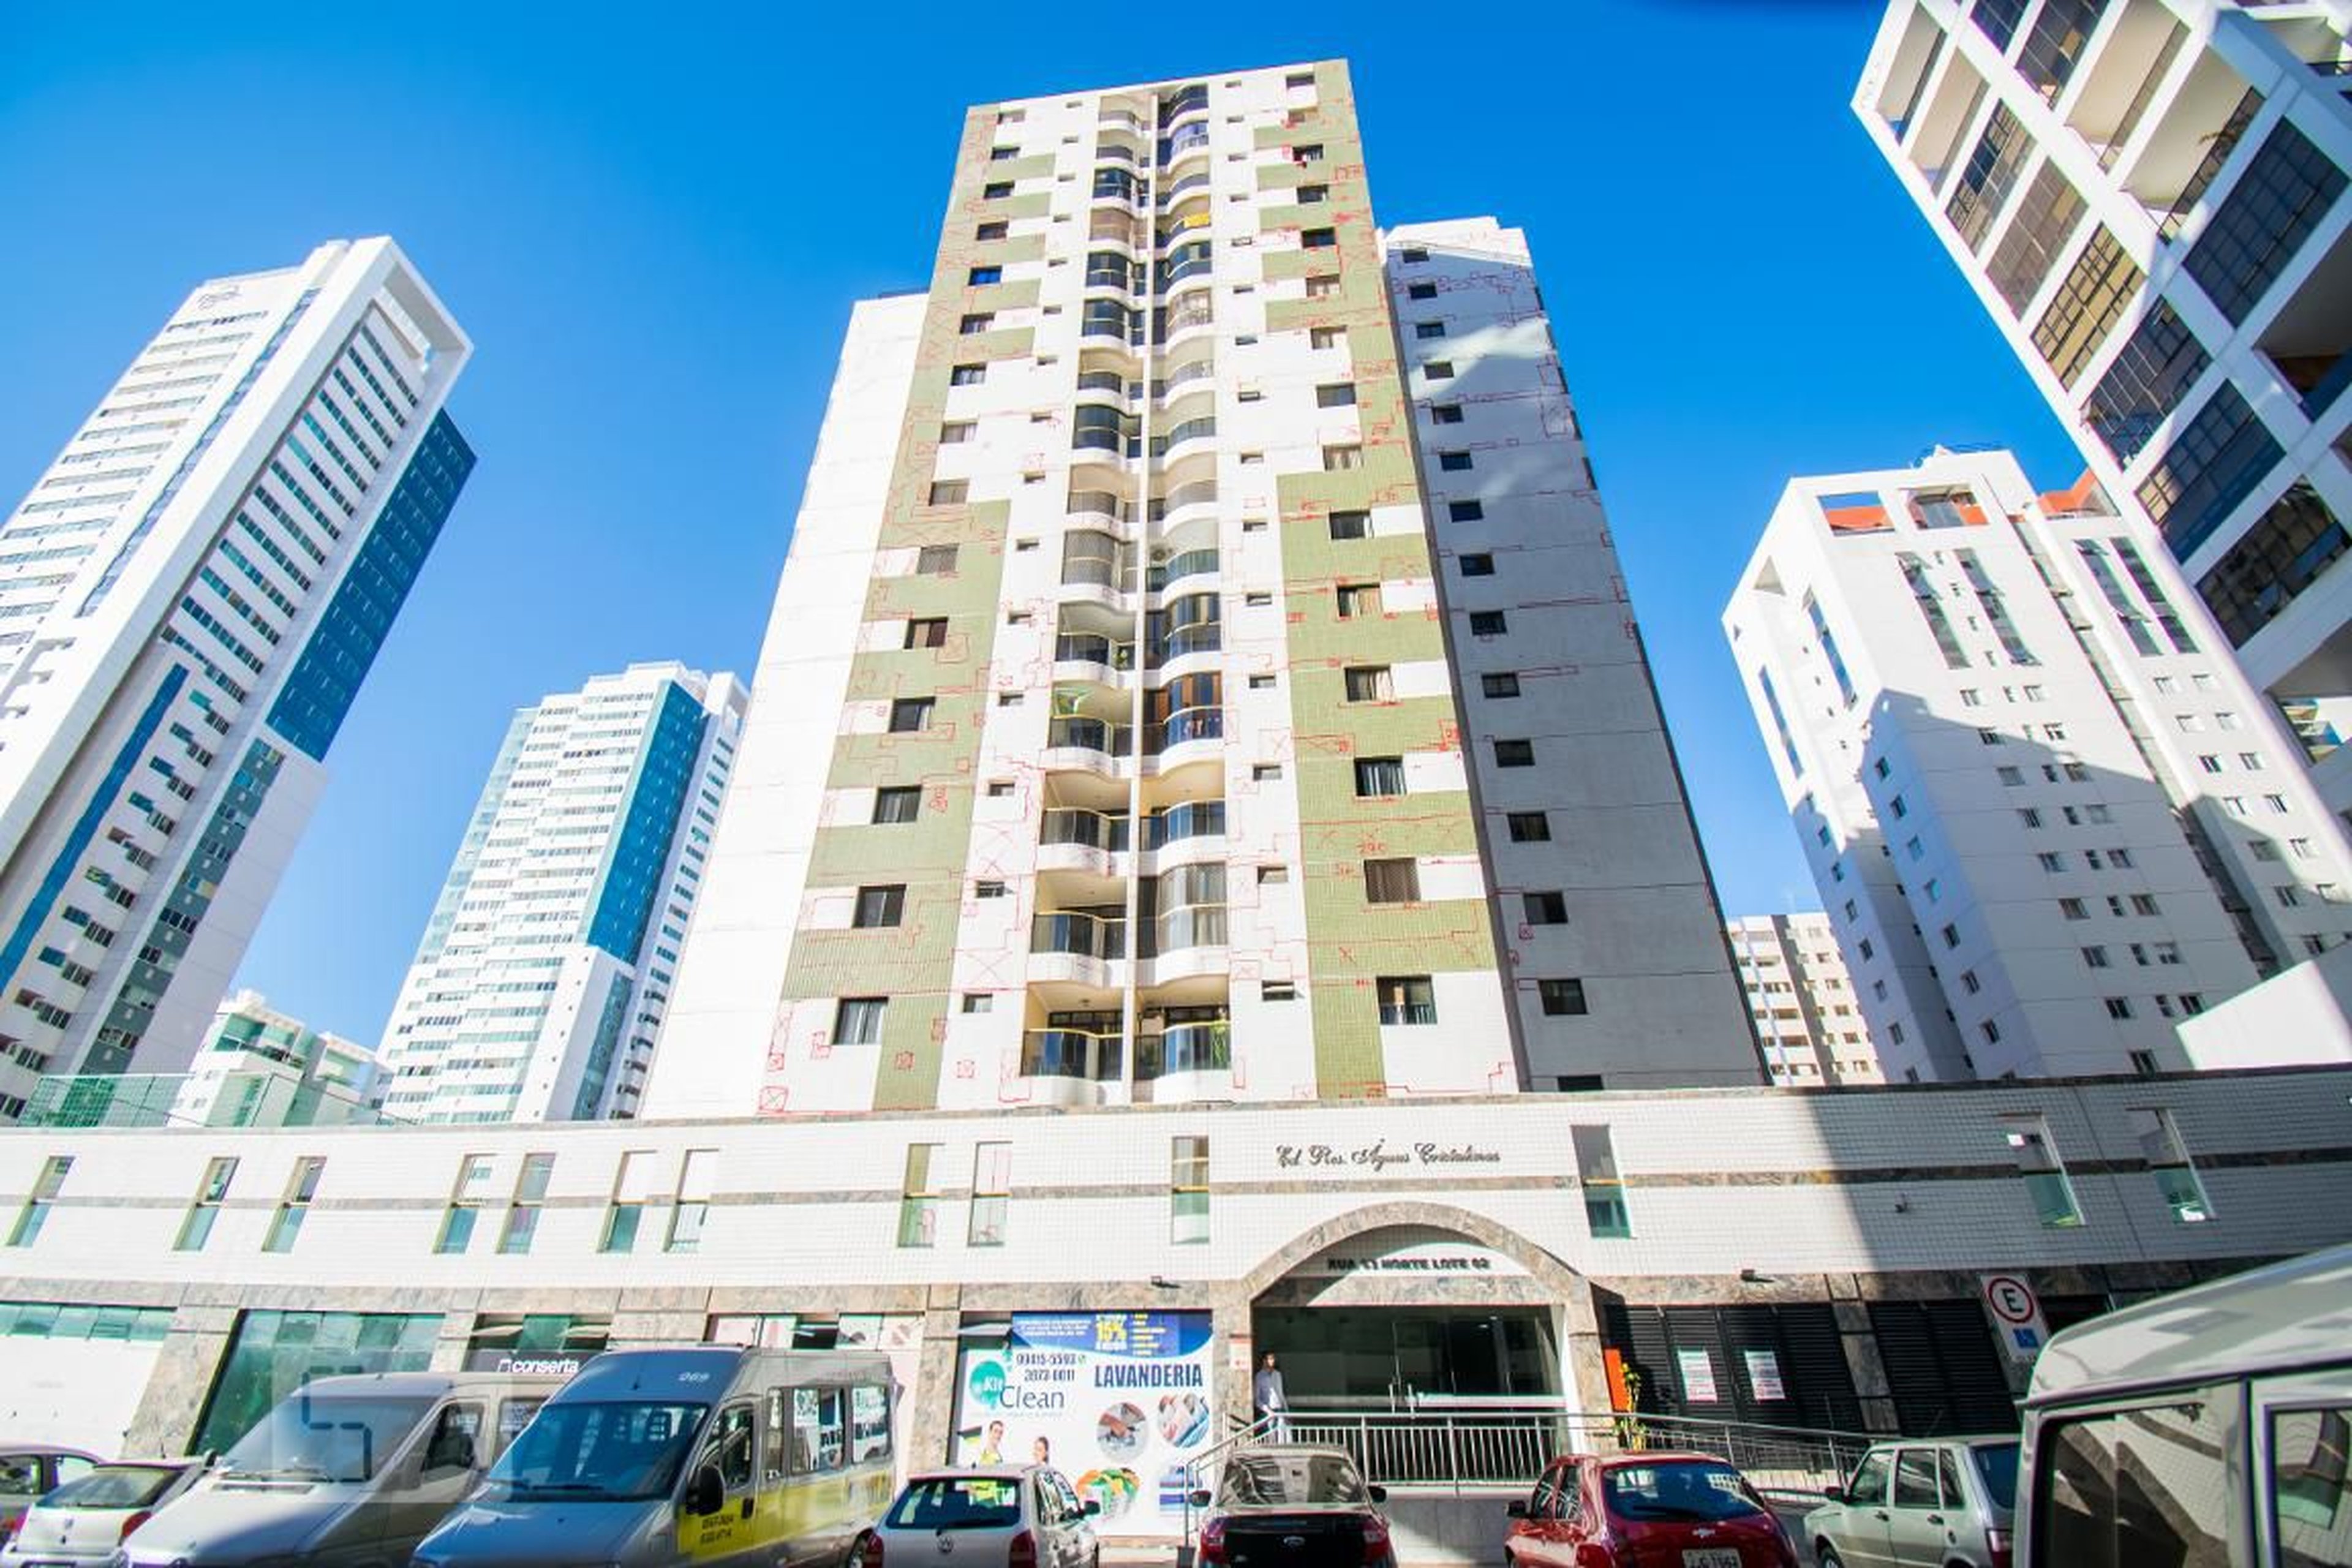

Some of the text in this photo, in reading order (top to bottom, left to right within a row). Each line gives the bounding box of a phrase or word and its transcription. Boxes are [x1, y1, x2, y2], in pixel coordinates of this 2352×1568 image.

[1327, 1258, 1357, 1270] RUA
[1381, 1259, 1429, 1270] NORTE
[1433, 1259, 1469, 1270] LOTE
[2000, 1288, 2024, 1312] E
[513, 1358, 578, 1373] conserta
[1094, 1364, 1203, 1388] LAVANDERIA
[1000, 1385, 1065, 1408] Clean
